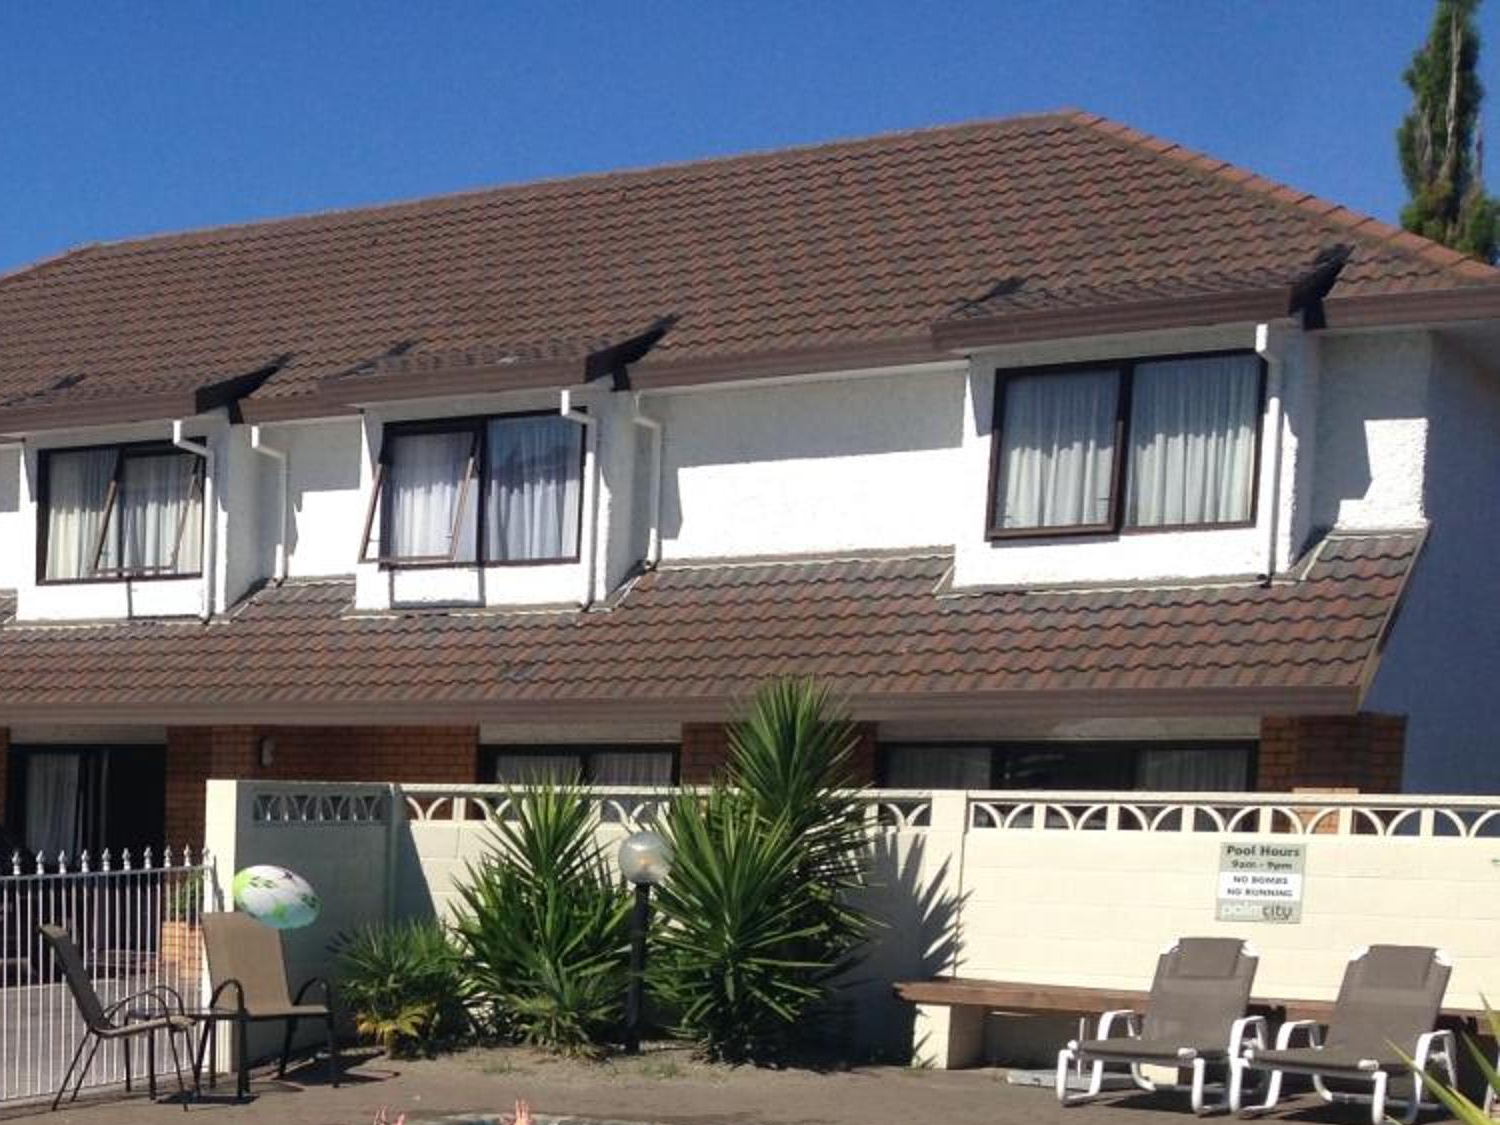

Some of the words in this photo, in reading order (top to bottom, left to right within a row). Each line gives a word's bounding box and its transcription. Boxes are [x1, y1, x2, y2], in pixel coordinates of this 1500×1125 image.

[1227, 845, 1256, 856] Pool
[1260, 845, 1300, 857] Hours
[1231, 860, 1257, 869] 9am
[1267, 861, 1293, 870] 9pm
[1233, 875, 1248, 883] NO
[1251, 876, 1288, 884] BOMBS
[1227, 888, 1242, 896] NO
[1245, 888, 1293, 897] RUNNING
